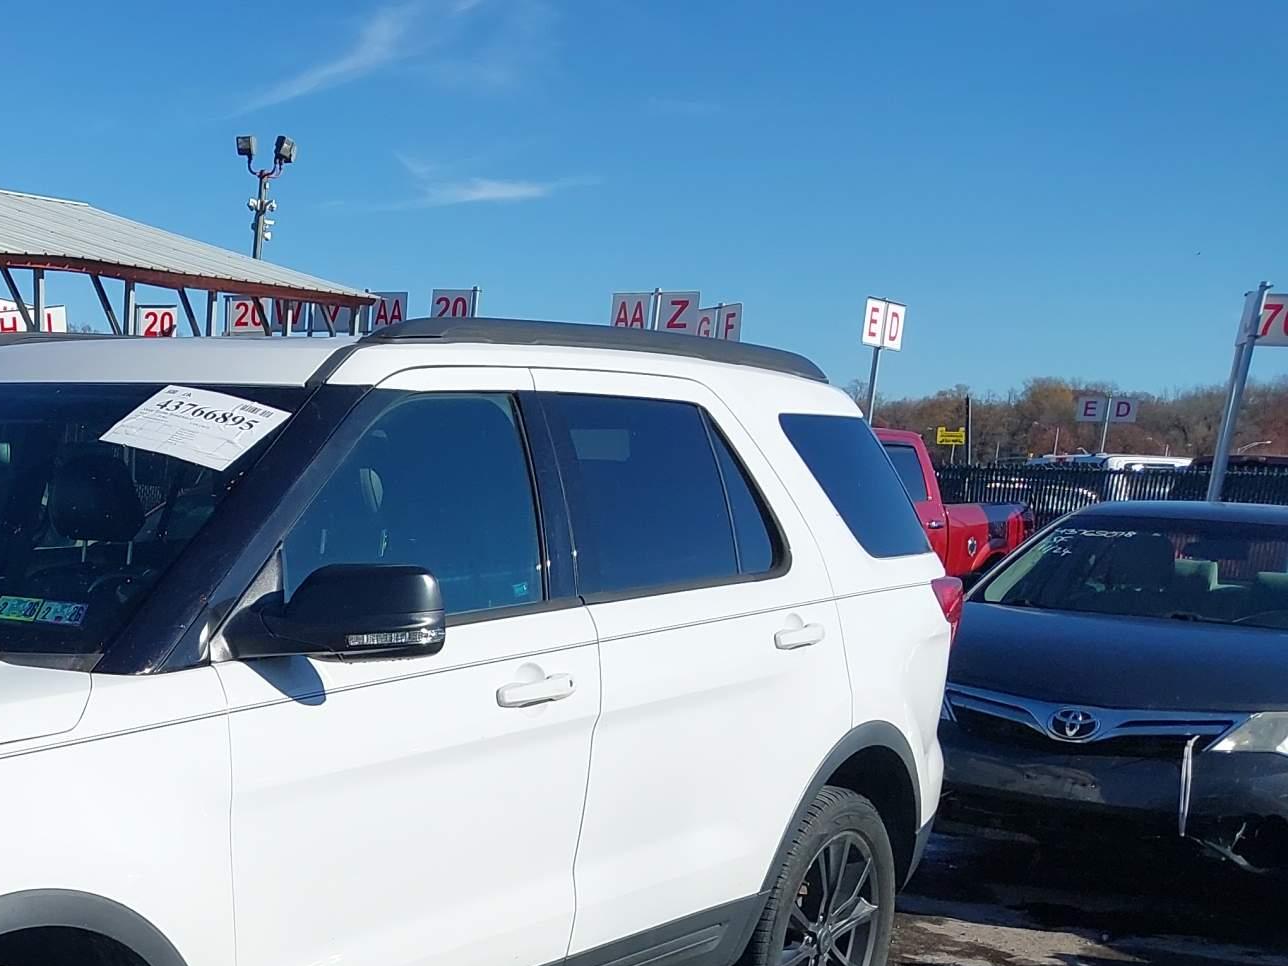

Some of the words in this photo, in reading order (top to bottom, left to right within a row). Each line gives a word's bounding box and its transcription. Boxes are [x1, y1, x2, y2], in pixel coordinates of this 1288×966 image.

[374, 299, 404, 326] AA
[435, 297, 469, 318] 20
[614, 300, 645, 328] AA
[666, 300, 690, 329] Z
[143, 311, 174, 337] 20
[697, 316, 711, 338] G
[868, 306, 880, 337] E
[888, 311, 900, 342] D
[156, 399, 261, 431] 43766895
[1083, 400, 1098, 417] E
[1115, 401, 1131, 418] D
